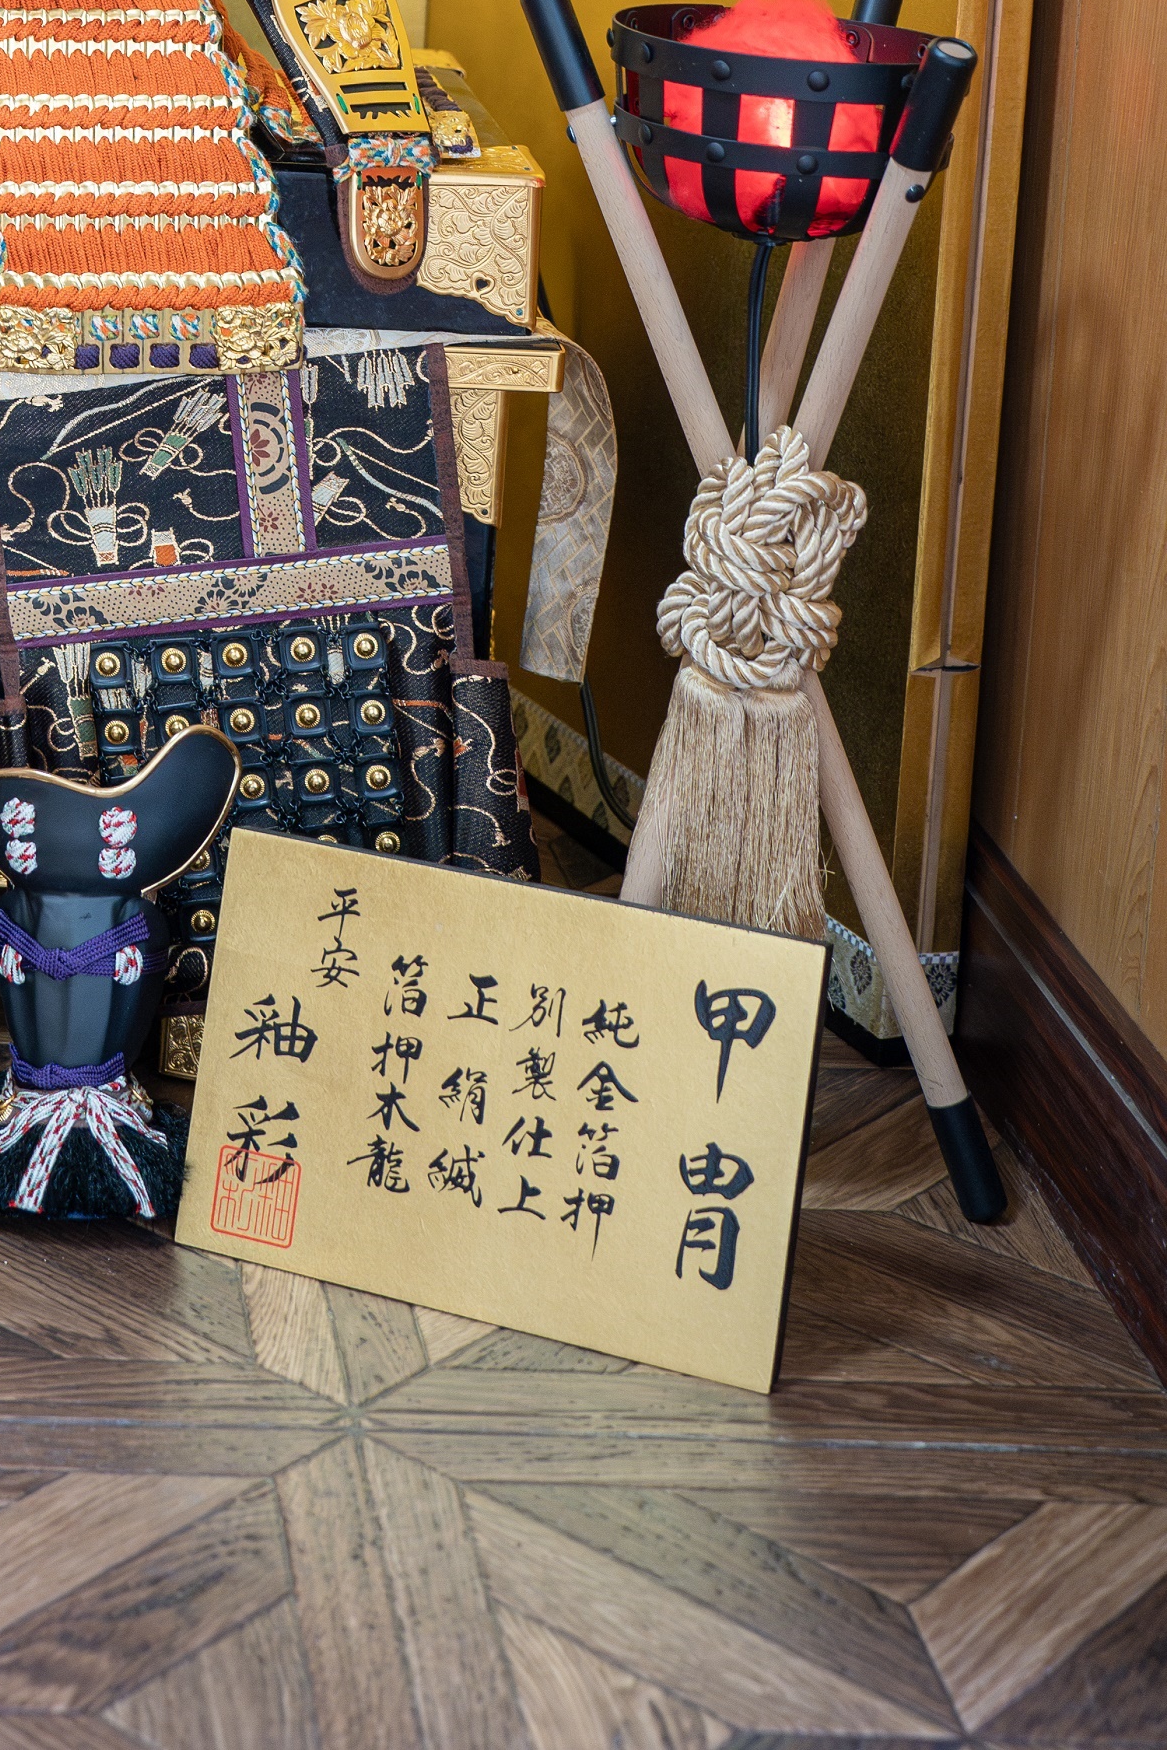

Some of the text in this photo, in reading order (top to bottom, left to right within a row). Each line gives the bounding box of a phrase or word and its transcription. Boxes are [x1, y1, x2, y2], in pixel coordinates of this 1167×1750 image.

[310, 887, 361, 988] 平安
[223, 992, 319, 1183] 釉彩
[497, 982, 566, 1221] 別製仕上
[560, 999, 640, 1256] 純金箔押
